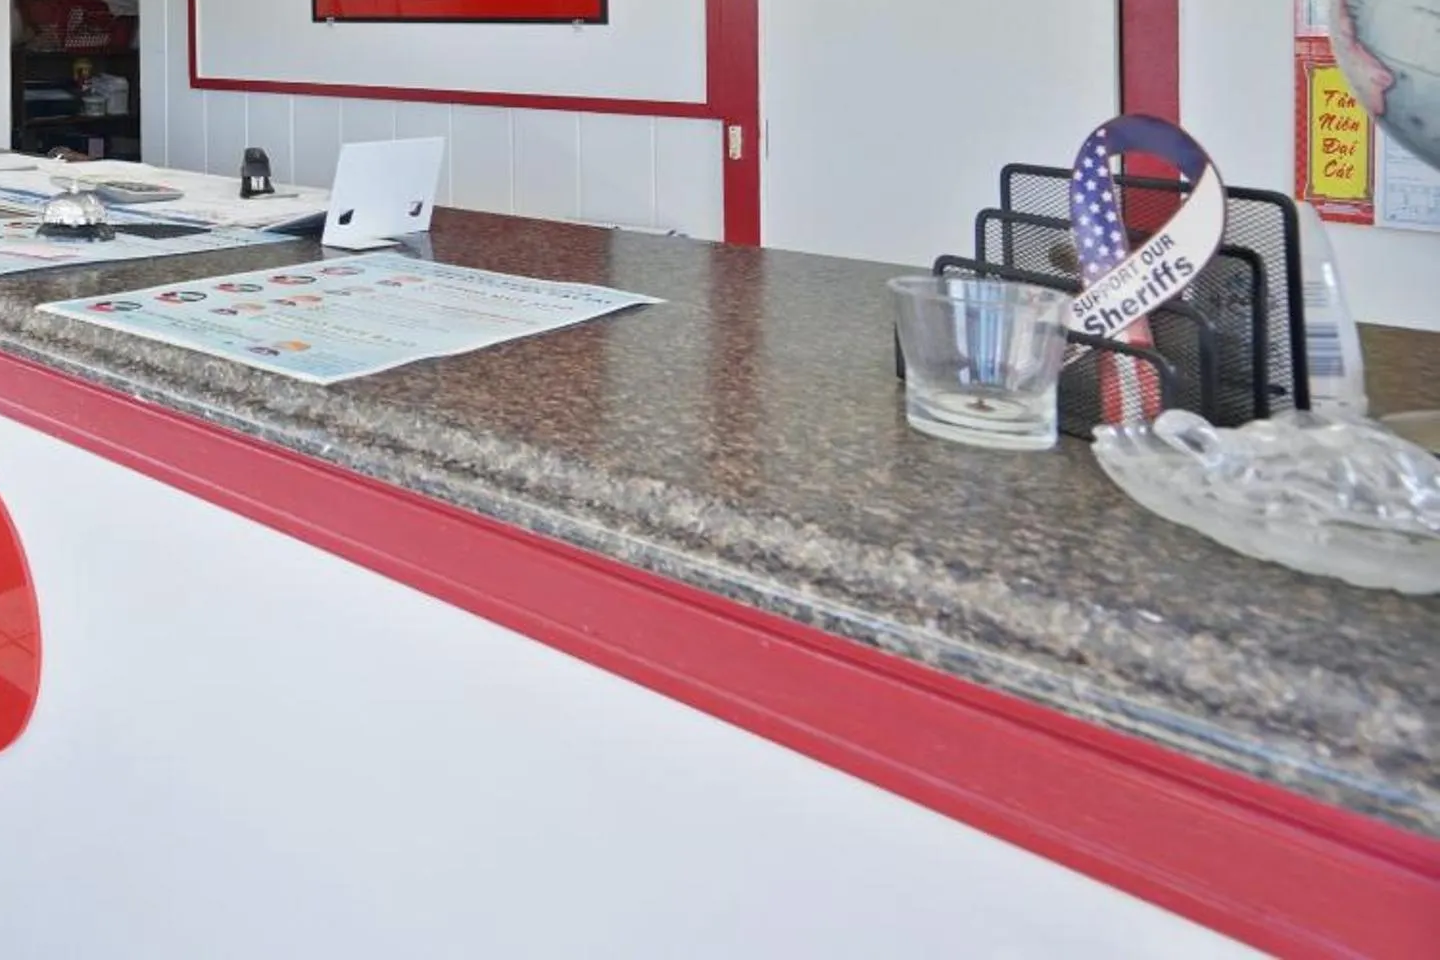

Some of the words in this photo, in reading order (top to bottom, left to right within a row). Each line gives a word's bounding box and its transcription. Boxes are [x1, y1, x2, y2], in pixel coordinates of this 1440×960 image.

[1073, 263, 1141, 318] SUPPORT
[1141, 235, 1175, 266] OUR
[1084, 256, 1194, 338] Sheriffs
